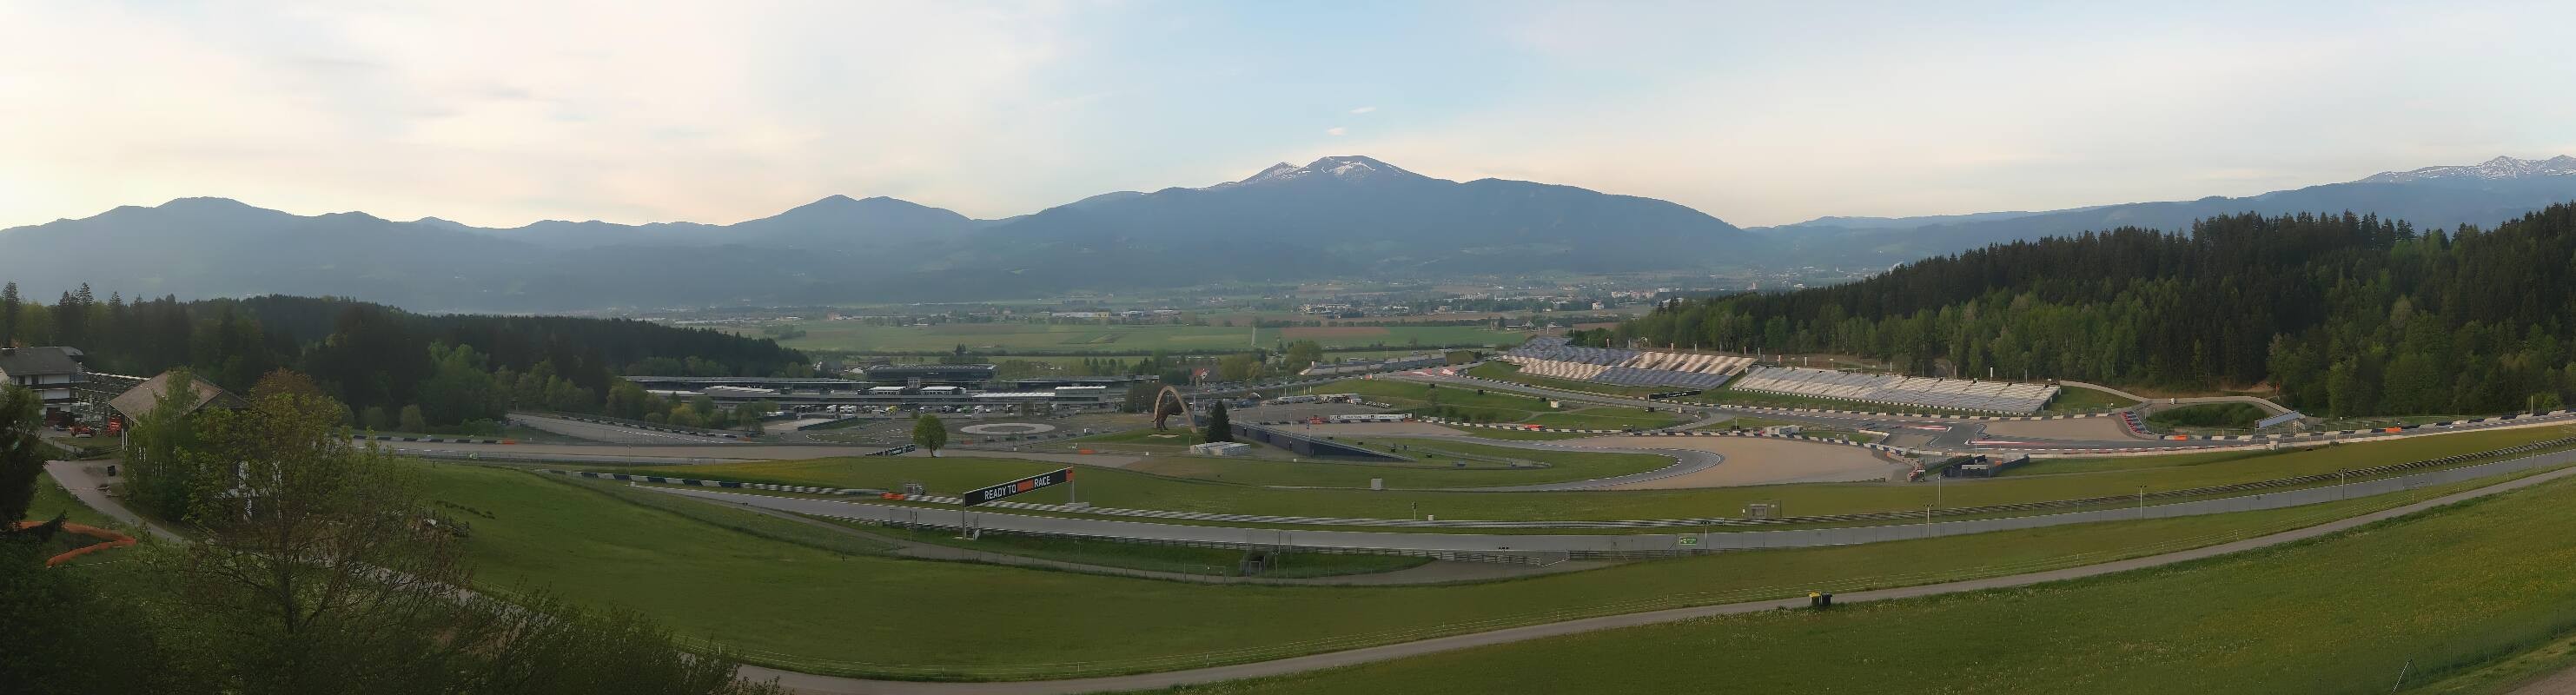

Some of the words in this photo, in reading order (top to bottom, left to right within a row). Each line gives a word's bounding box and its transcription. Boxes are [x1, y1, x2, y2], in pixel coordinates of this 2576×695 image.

[984, 486, 1006, 500] READY
[1008, 484, 1016, 494] TO
[1034, 476, 1050, 487] RACE
